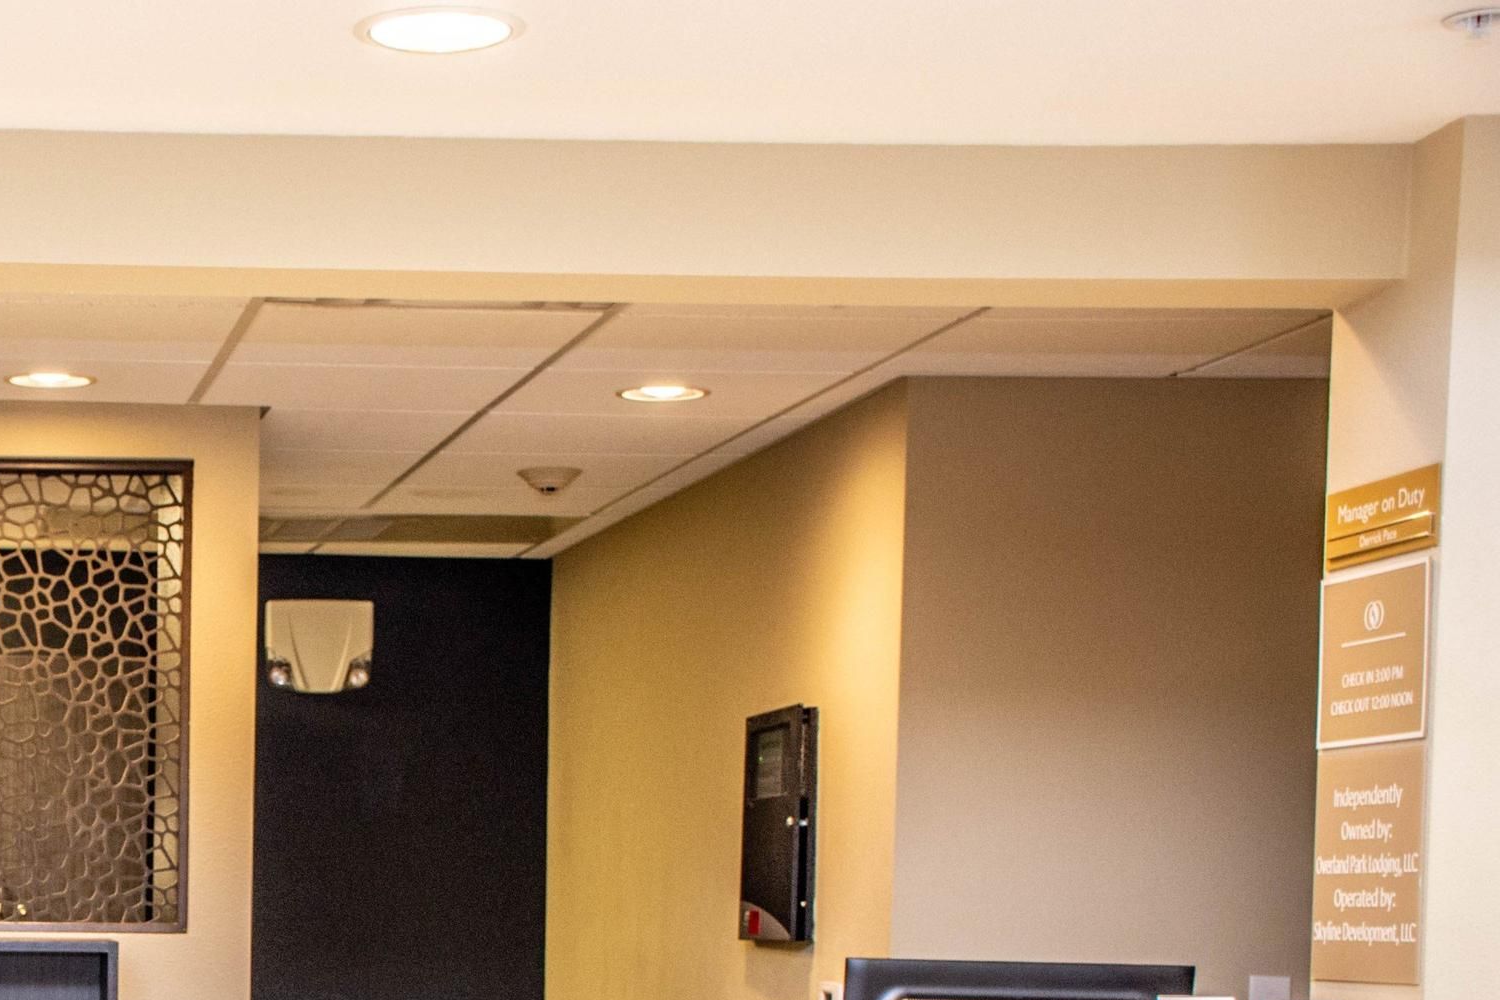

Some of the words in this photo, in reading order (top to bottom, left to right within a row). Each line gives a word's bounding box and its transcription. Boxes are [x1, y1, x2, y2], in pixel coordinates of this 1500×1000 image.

[1337, 502, 1379, 524] Manager
[1381, 496, 1396, 512] on
[1398, 487, 1425, 508] Duty
[1342, 671, 1365, 688] CHECK
[1366, 669, 1374, 684] IN
[1375, 667, 1391, 683] 3:00
[1392, 665, 1404, 680] PM
[1330, 701, 1353, 716] CHECK
[1354, 699, 1370, 713] OUT
[1371, 695, 1391, 711] 12:00
[1391, 691, 1414, 706] NOON
[1334, 784, 1402, 810] Independently
[1341, 821, 1375, 841] Owned
[1376, 820, 1393, 843] by:
[1316, 855, 1349, 875] Overland
[1349, 855, 1367, 874] Park
[1368, 853, 1403, 877] Lodging,
[1403, 853, 1419, 873] LLC
[1334, 889, 1379, 911] Operated
[1379, 887, 1396, 912] by:
[1342, 922, 1400, 946] Development,
[1400, 923, 1417, 943] LLC
